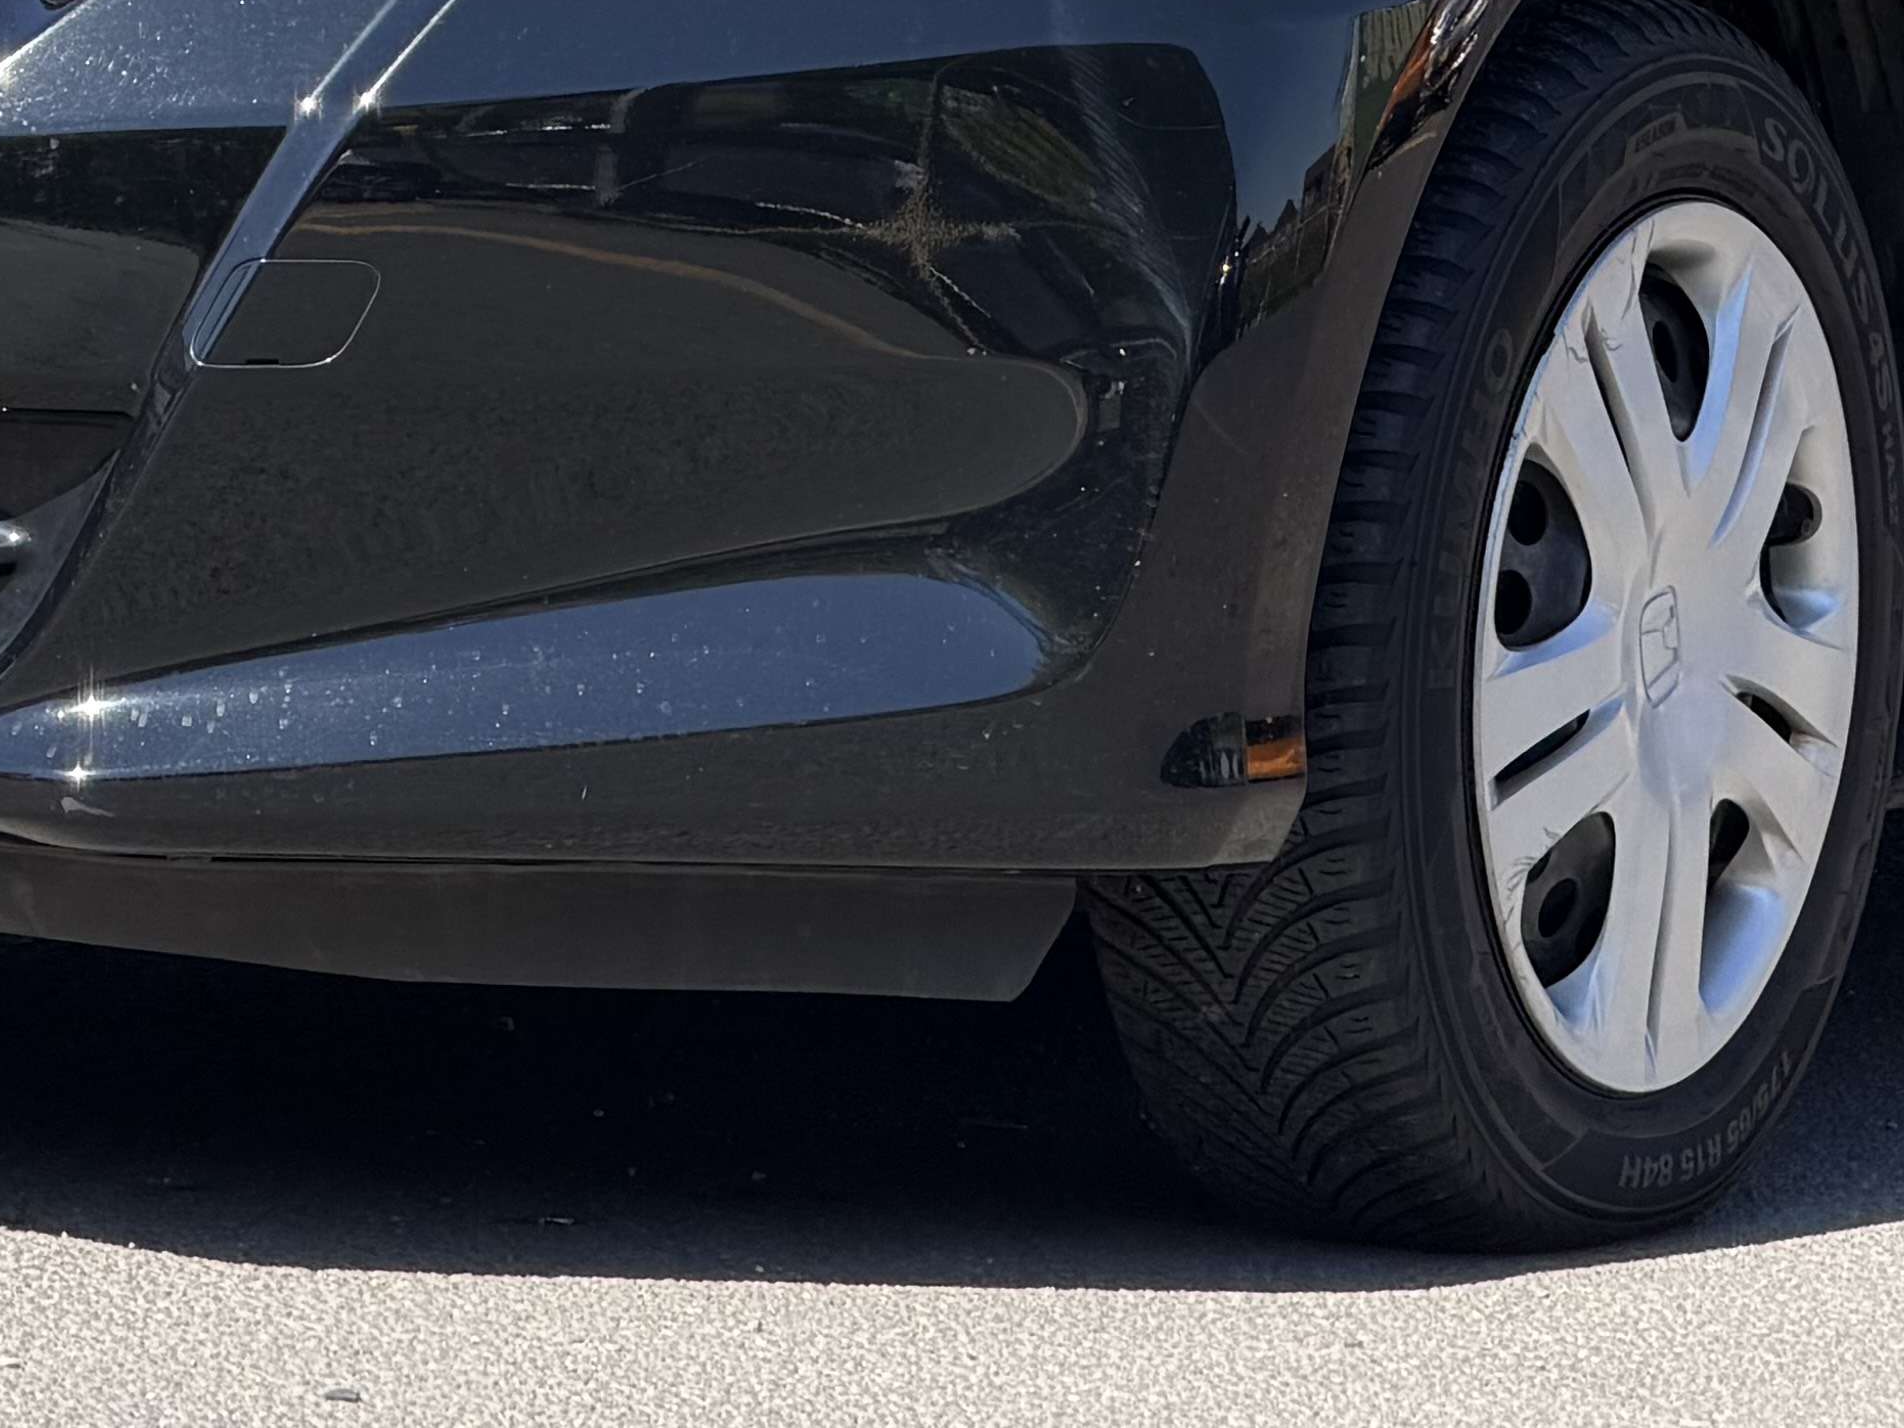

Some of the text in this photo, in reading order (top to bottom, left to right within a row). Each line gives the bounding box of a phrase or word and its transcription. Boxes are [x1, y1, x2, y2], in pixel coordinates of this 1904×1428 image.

[1761, 116, 1872, 326] SOLUS
[1616, 1152, 1674, 1190] 84H
[1679, 1132, 1723, 1182] R15
